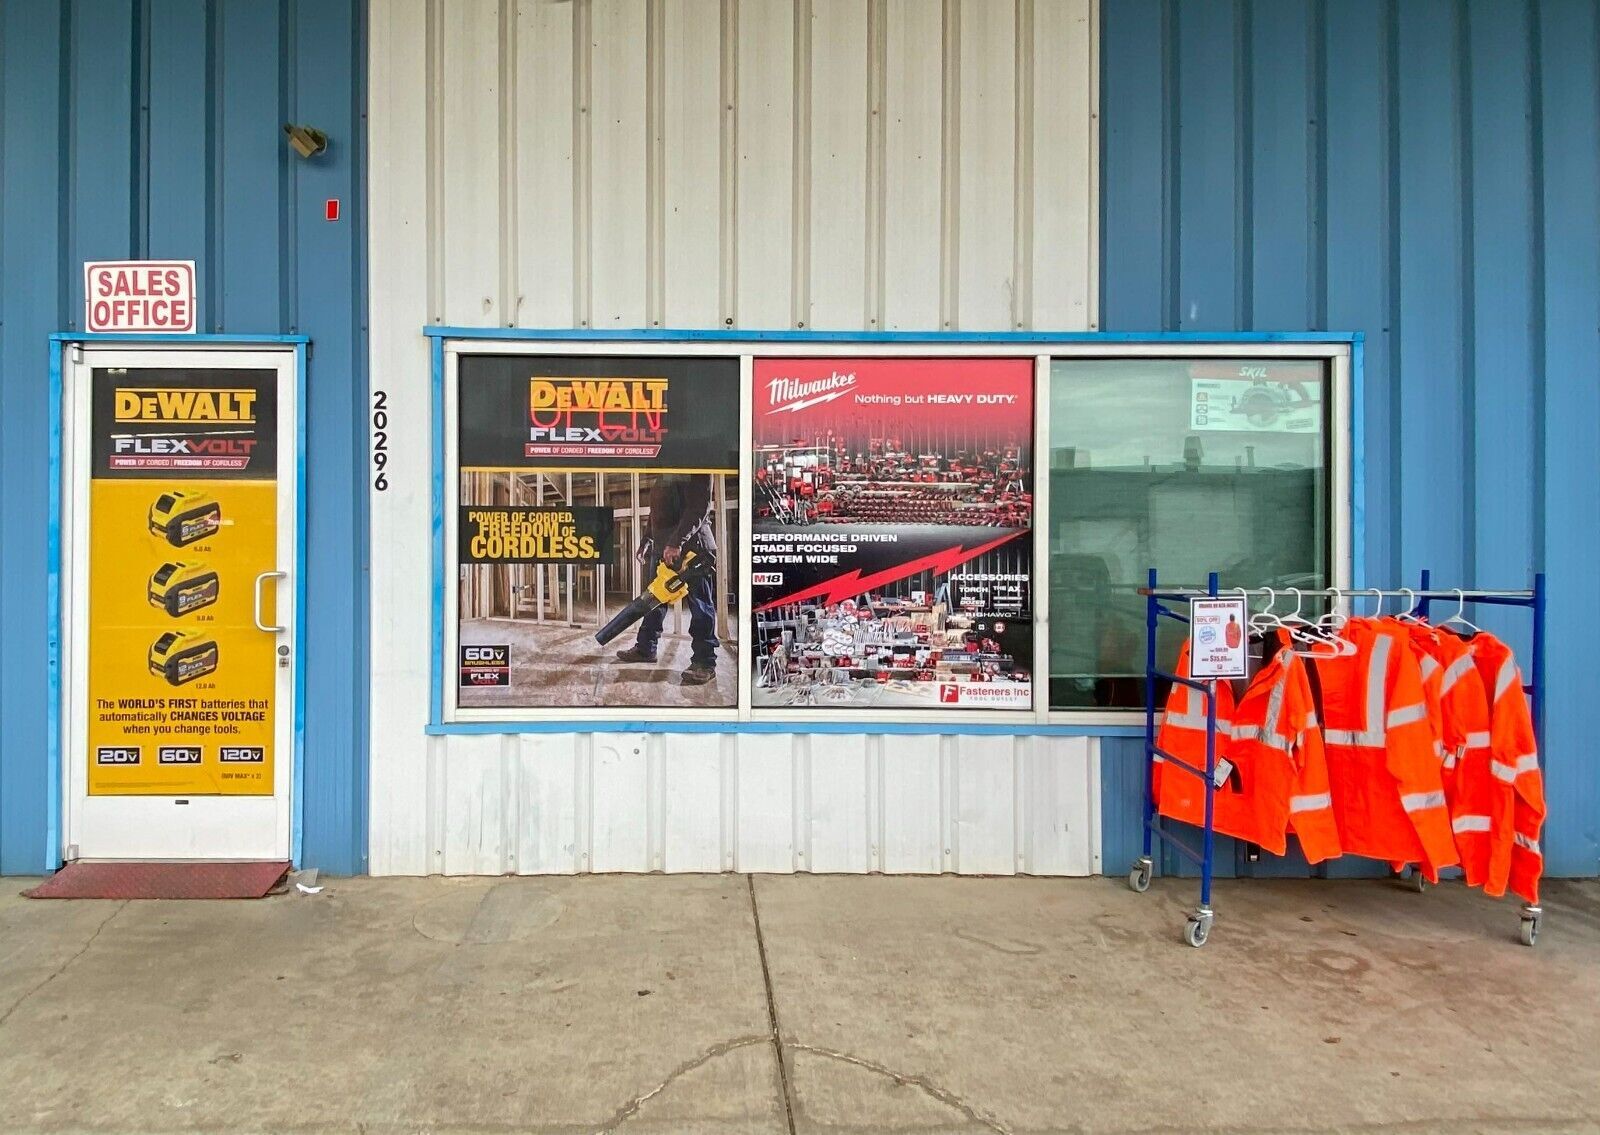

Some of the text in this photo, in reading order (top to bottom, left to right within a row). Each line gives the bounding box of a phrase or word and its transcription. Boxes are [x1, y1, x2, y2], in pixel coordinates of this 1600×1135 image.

[98, 270, 180, 297] SALES
[94, 300, 186, 326] OFFICE
[1239, 367, 1267, 378] SKIL
[765, 371, 857, 405] Milwaukee
[115, 391, 256, 420] DEWALT
[855, 394, 901, 406] Nothing
[905, 394, 925, 404] but
[927, 394, 973, 404] HEAVY
[531, 427, 668, 442] FLEXVOLT
[115, 438, 257, 454] FLEXVOLT
[373, 391, 388, 491] 20296
[469, 511, 575, 523] POWER OF CORDED.
[480, 522, 576, 538] FREEDOM OF
[752, 533, 898, 542] PERFORMANCE DRIVEN
[471, 536, 600, 559] CORDLESS.
[752, 544, 857, 553] TRADE FOCUSED
[752, 555, 838, 563] SYSTEM WIDE
[753, 574, 781, 583] M18
[951, 573, 1029, 581] ACCESSORIES
[470, 672, 499, 680] FLEX
[960, 686, 1011, 696] Fasteners
[1014, 688, 1030, 697] Inc
[97, 699, 268, 709] The WORLD'S FIRST batteries that
[99, 711, 266, 723] automatically CHANGES VOLTAGE
[123, 724, 241, 735] when you change tools.
